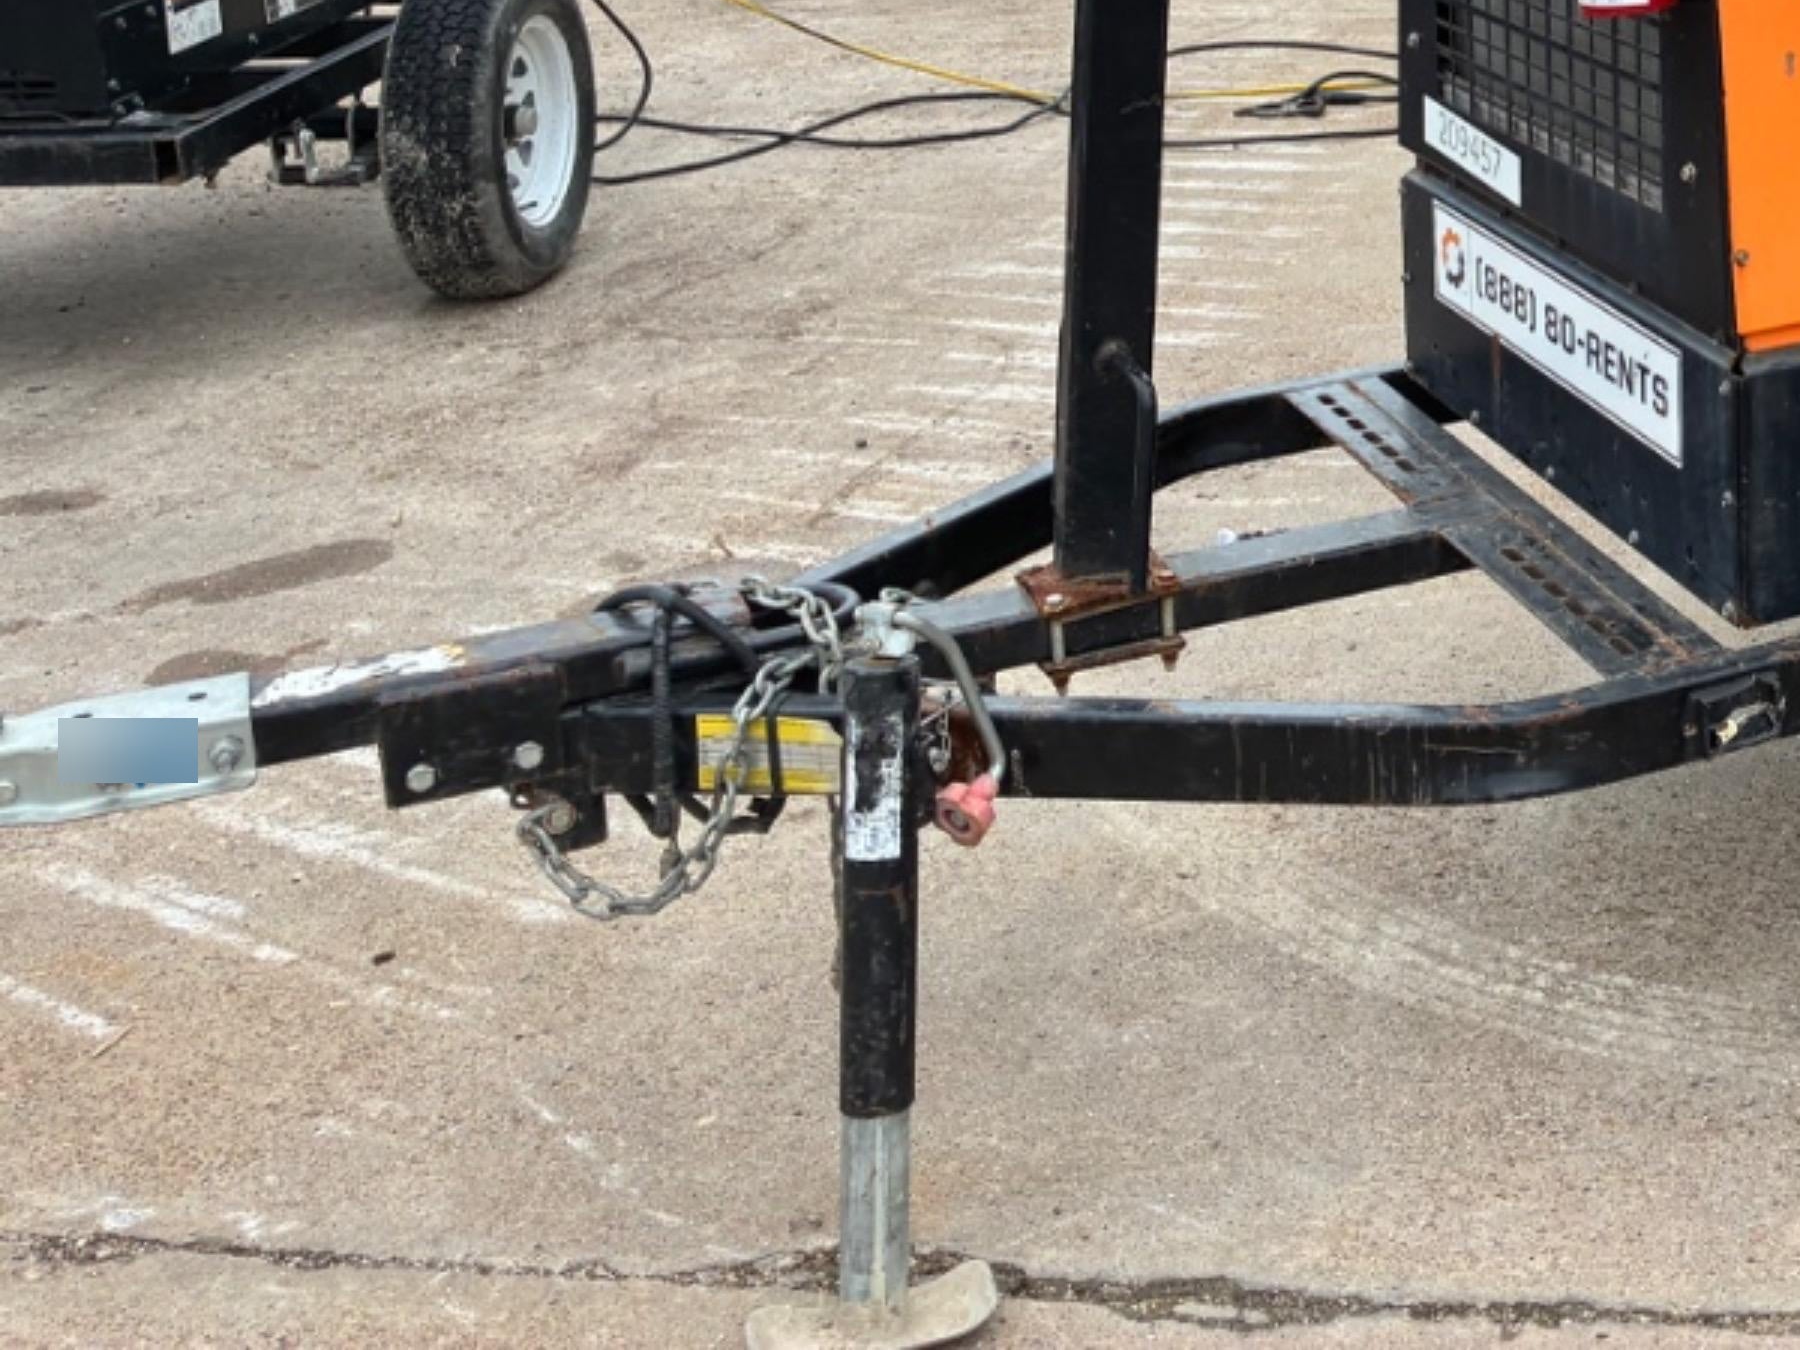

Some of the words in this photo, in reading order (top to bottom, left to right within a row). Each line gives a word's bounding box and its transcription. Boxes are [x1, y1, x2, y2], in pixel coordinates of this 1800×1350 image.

[1439, 110, 1502, 178] 209457
[1475, 256, 1537, 334] (888)
[1543, 302, 1670, 419] 80-RENTS
